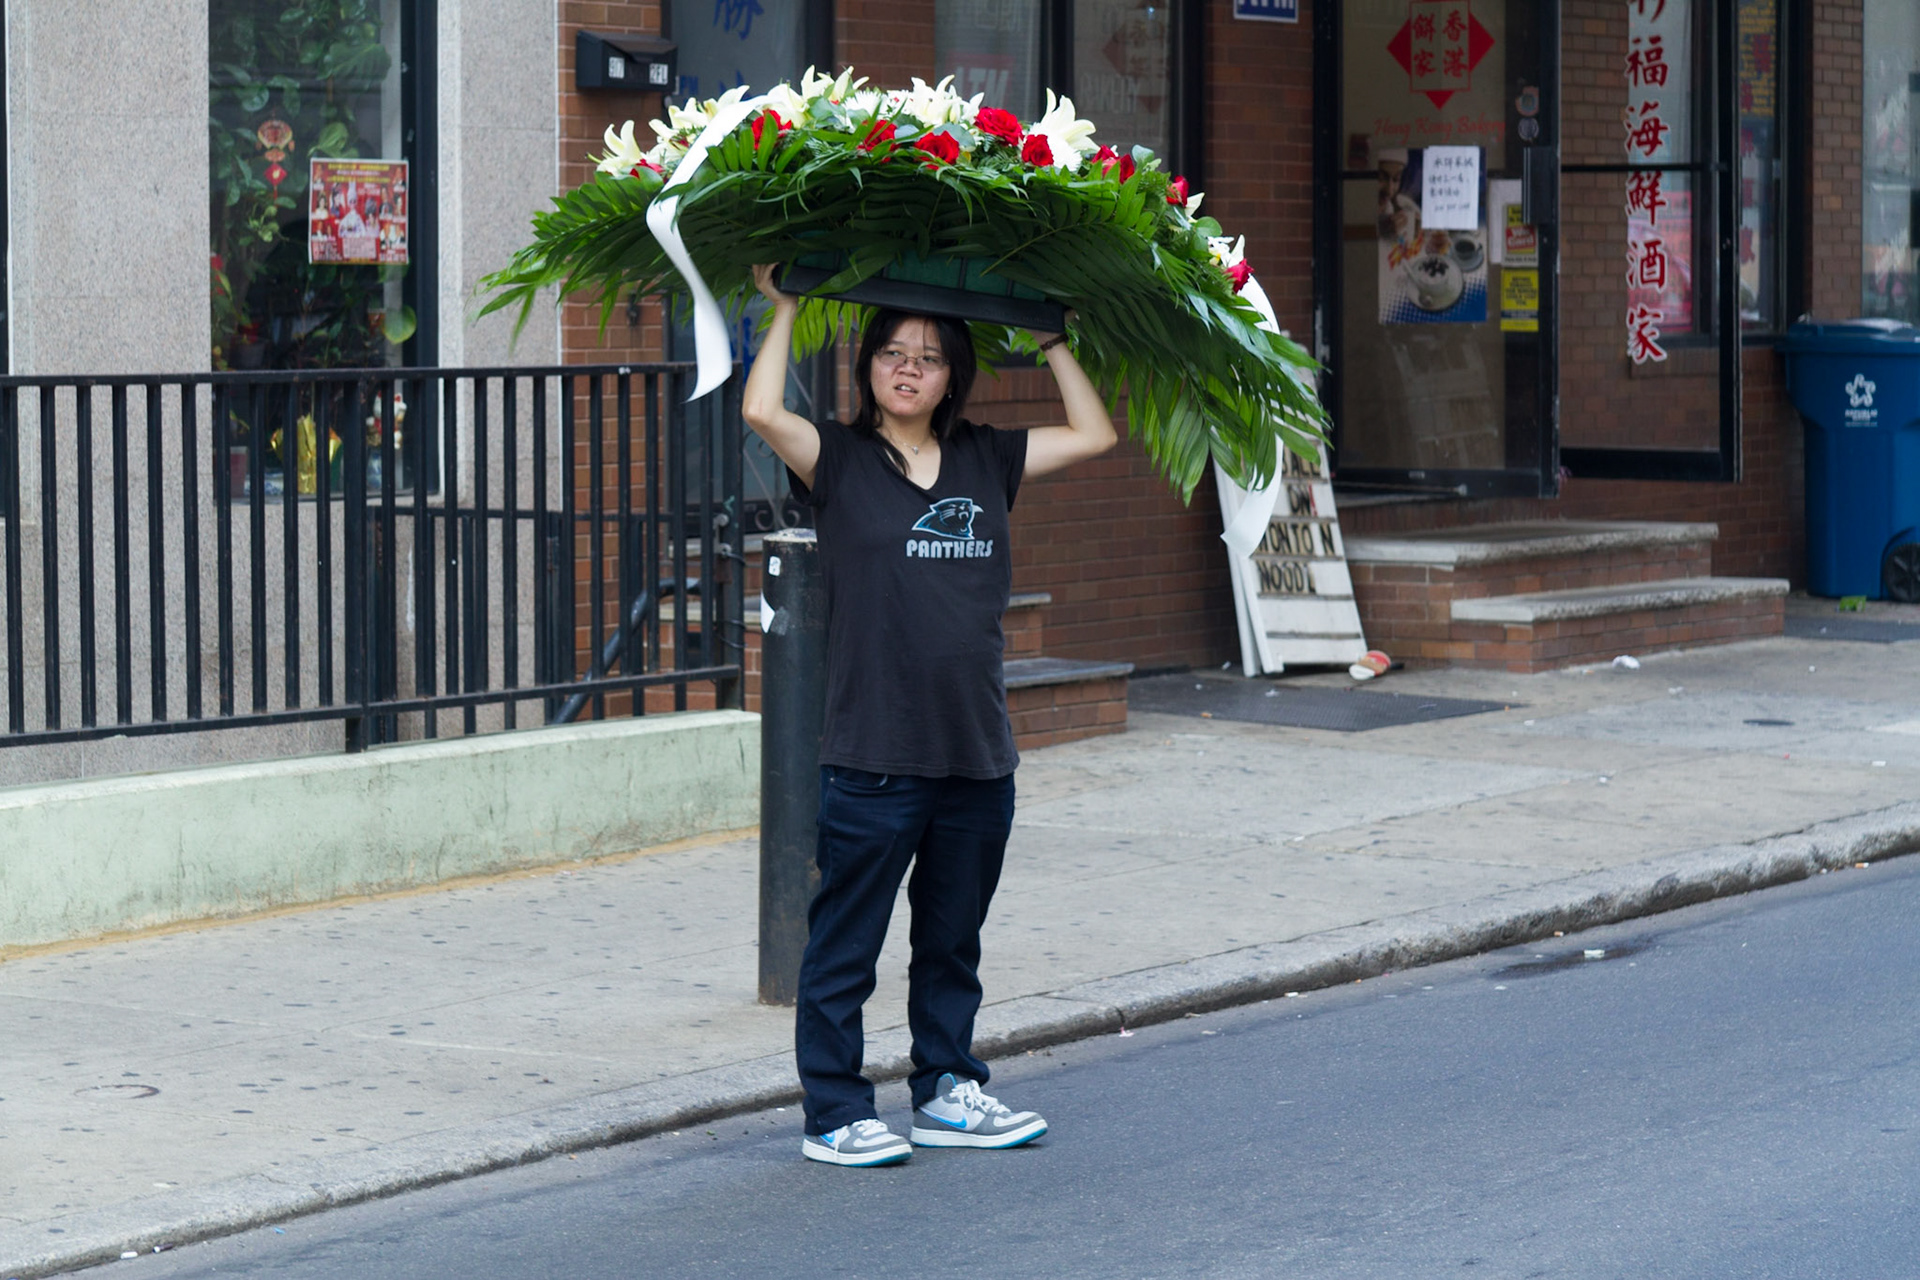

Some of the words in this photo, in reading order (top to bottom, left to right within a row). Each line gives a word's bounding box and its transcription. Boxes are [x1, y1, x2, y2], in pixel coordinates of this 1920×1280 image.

[1374, 116, 1412, 144] Hong
[1415, 115, 1453, 143] Kong
[1457, 112, 1506, 142] Bakery
[906, 539, 993, 558] PANTHERS
